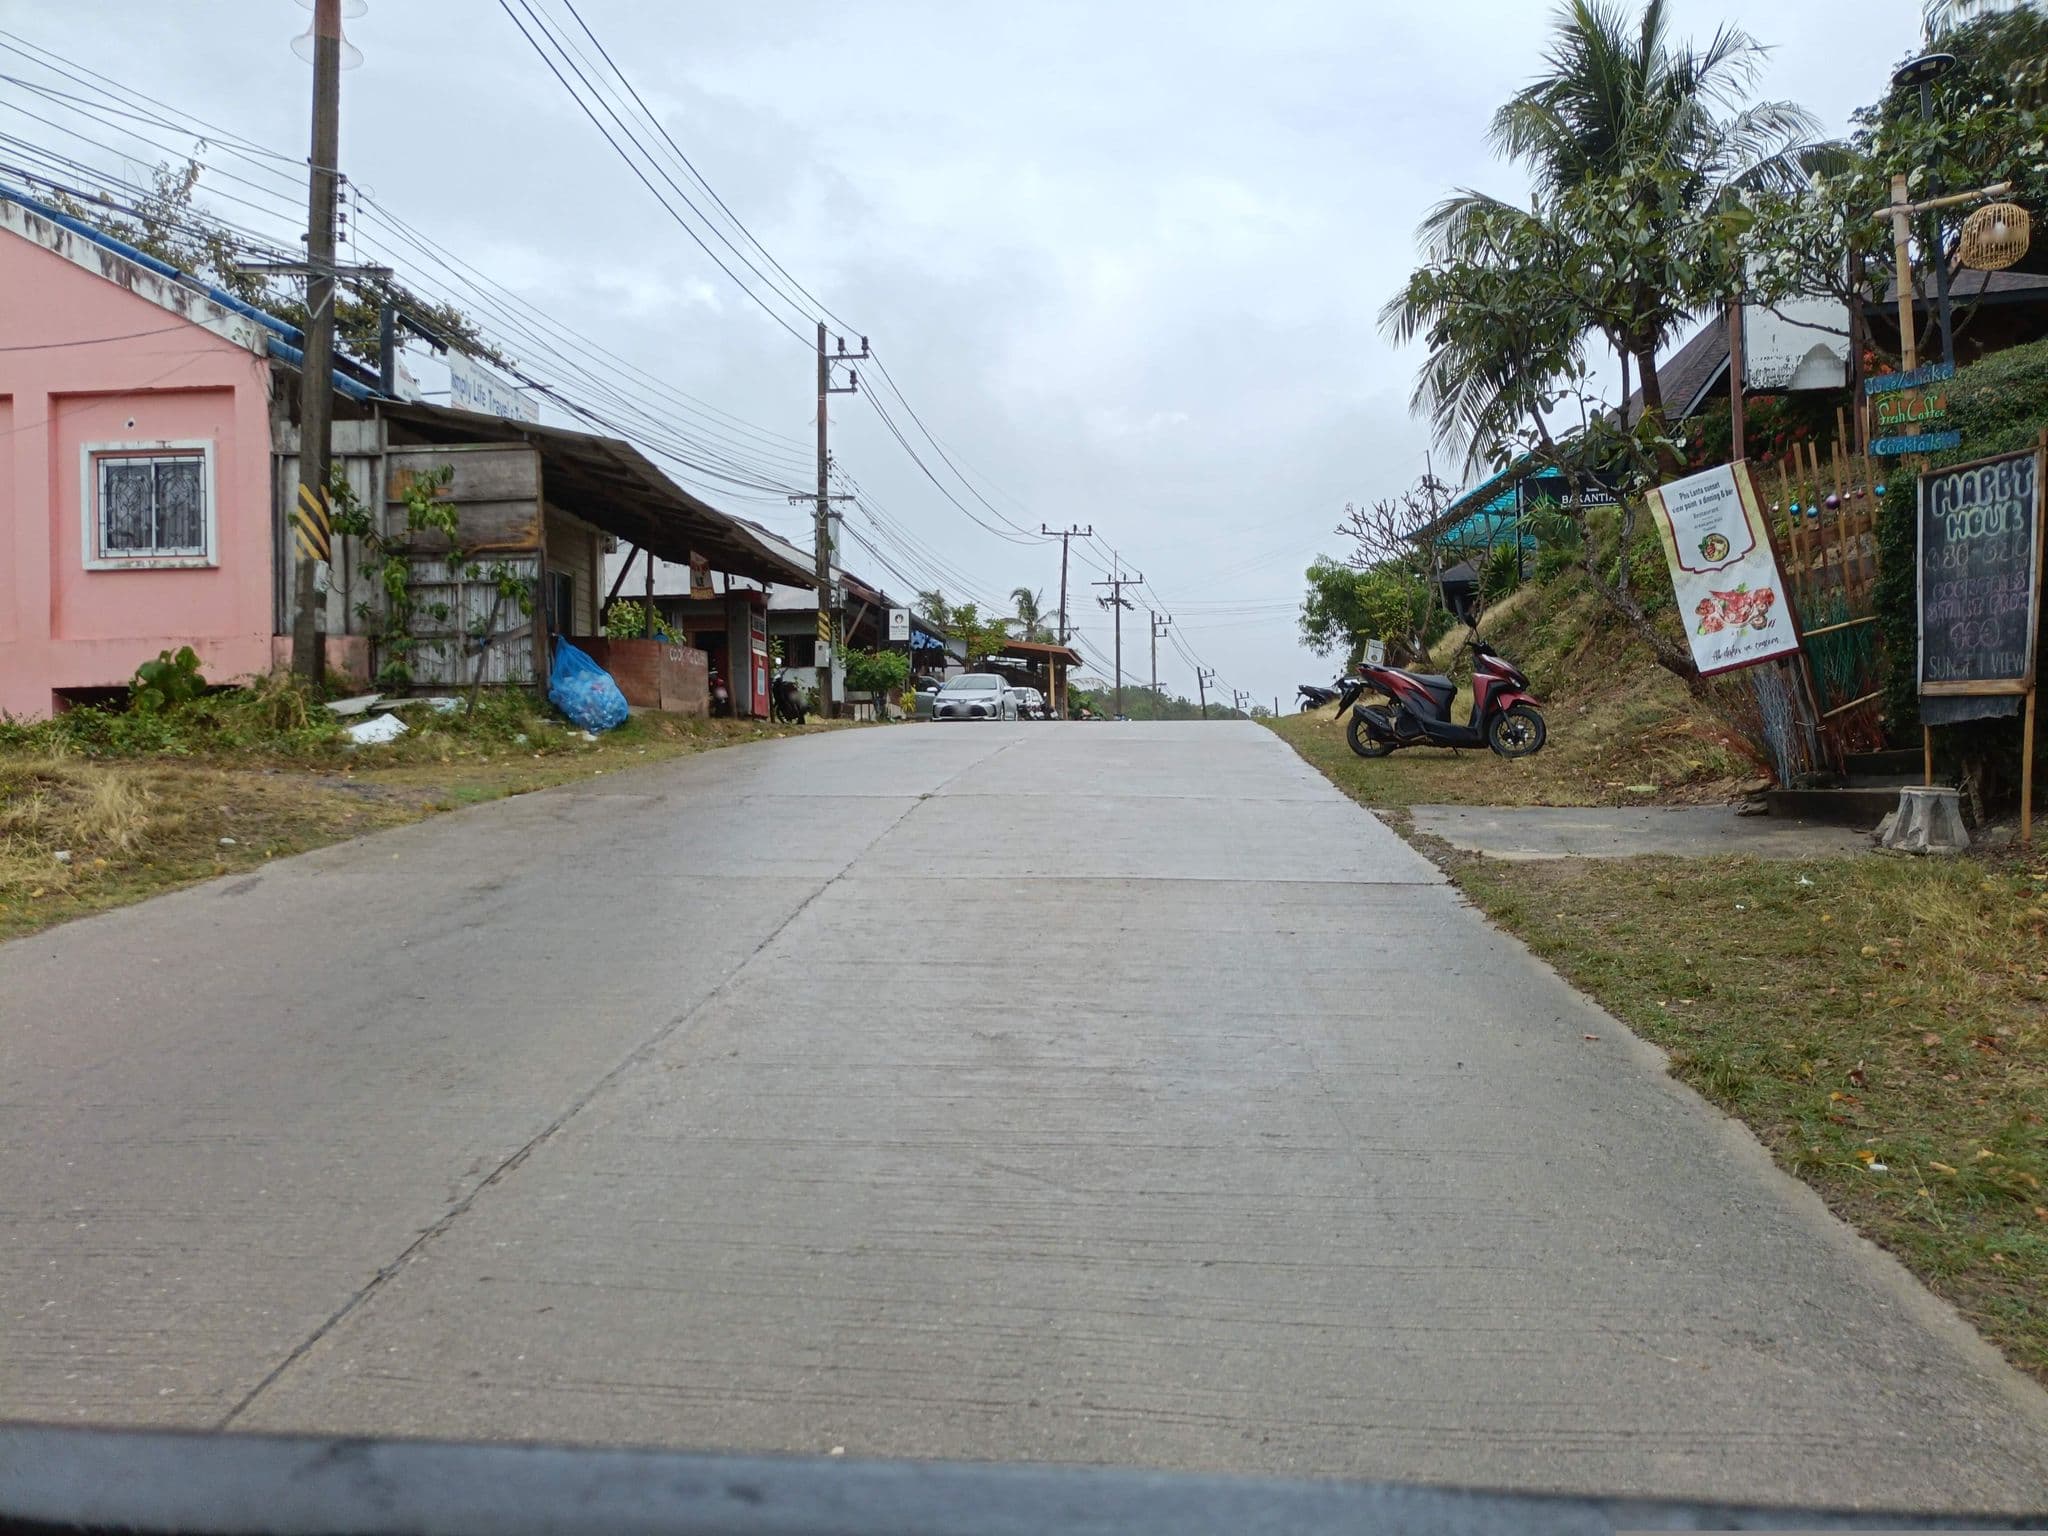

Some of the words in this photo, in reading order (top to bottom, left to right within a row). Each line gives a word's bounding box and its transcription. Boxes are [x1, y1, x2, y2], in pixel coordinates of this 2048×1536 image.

[473, 379, 487, 408] Life
[1878, 400, 1906, 426] Fresh
[1906, 396, 1947, 422] Coffee
[1875, 433, 1943, 456] Cocktails
[1931, 456, 2034, 518] HAPPY
[1693, 506, 1720, 520] Restaurant
[1946, 502, 2025, 544] HOUR
